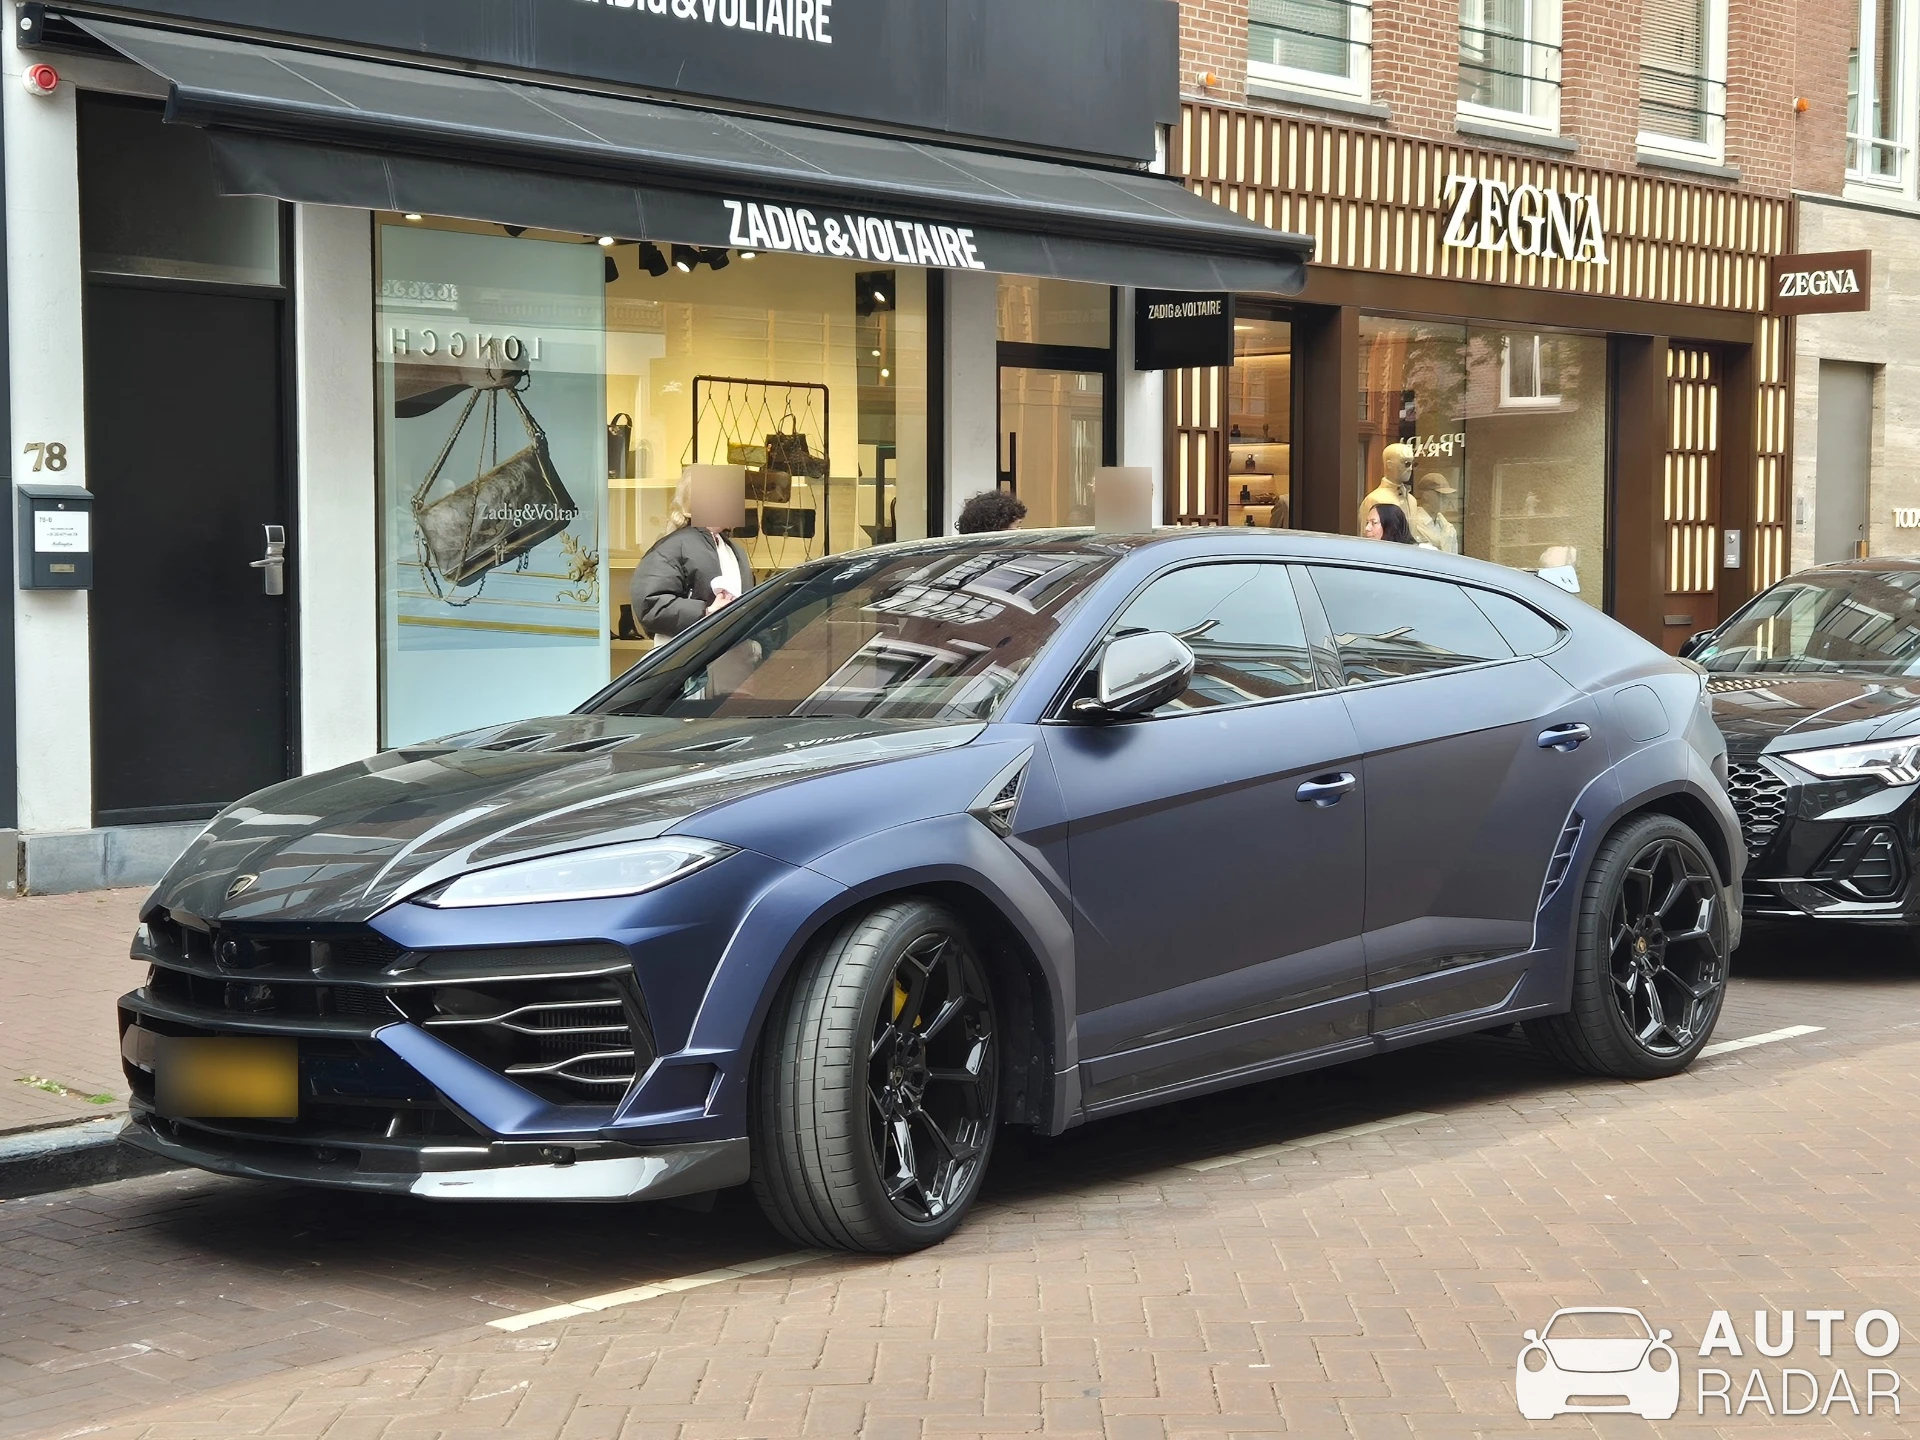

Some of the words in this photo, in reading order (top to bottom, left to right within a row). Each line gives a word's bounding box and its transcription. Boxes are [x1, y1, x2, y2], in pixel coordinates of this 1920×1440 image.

[582, 0, 833, 44] VOLTAIRE
[722, 199, 986, 270] ZADIG&VOLTAIRE
[1442, 174, 1610, 265] ZEGNA
[1779, 268, 1860, 297] ZEGNA
[1148, 300, 1222, 319] ZADIG&VOLTAIRE
[23, 442, 67, 472] 78
[1892, 507, 1920, 528] TOD
